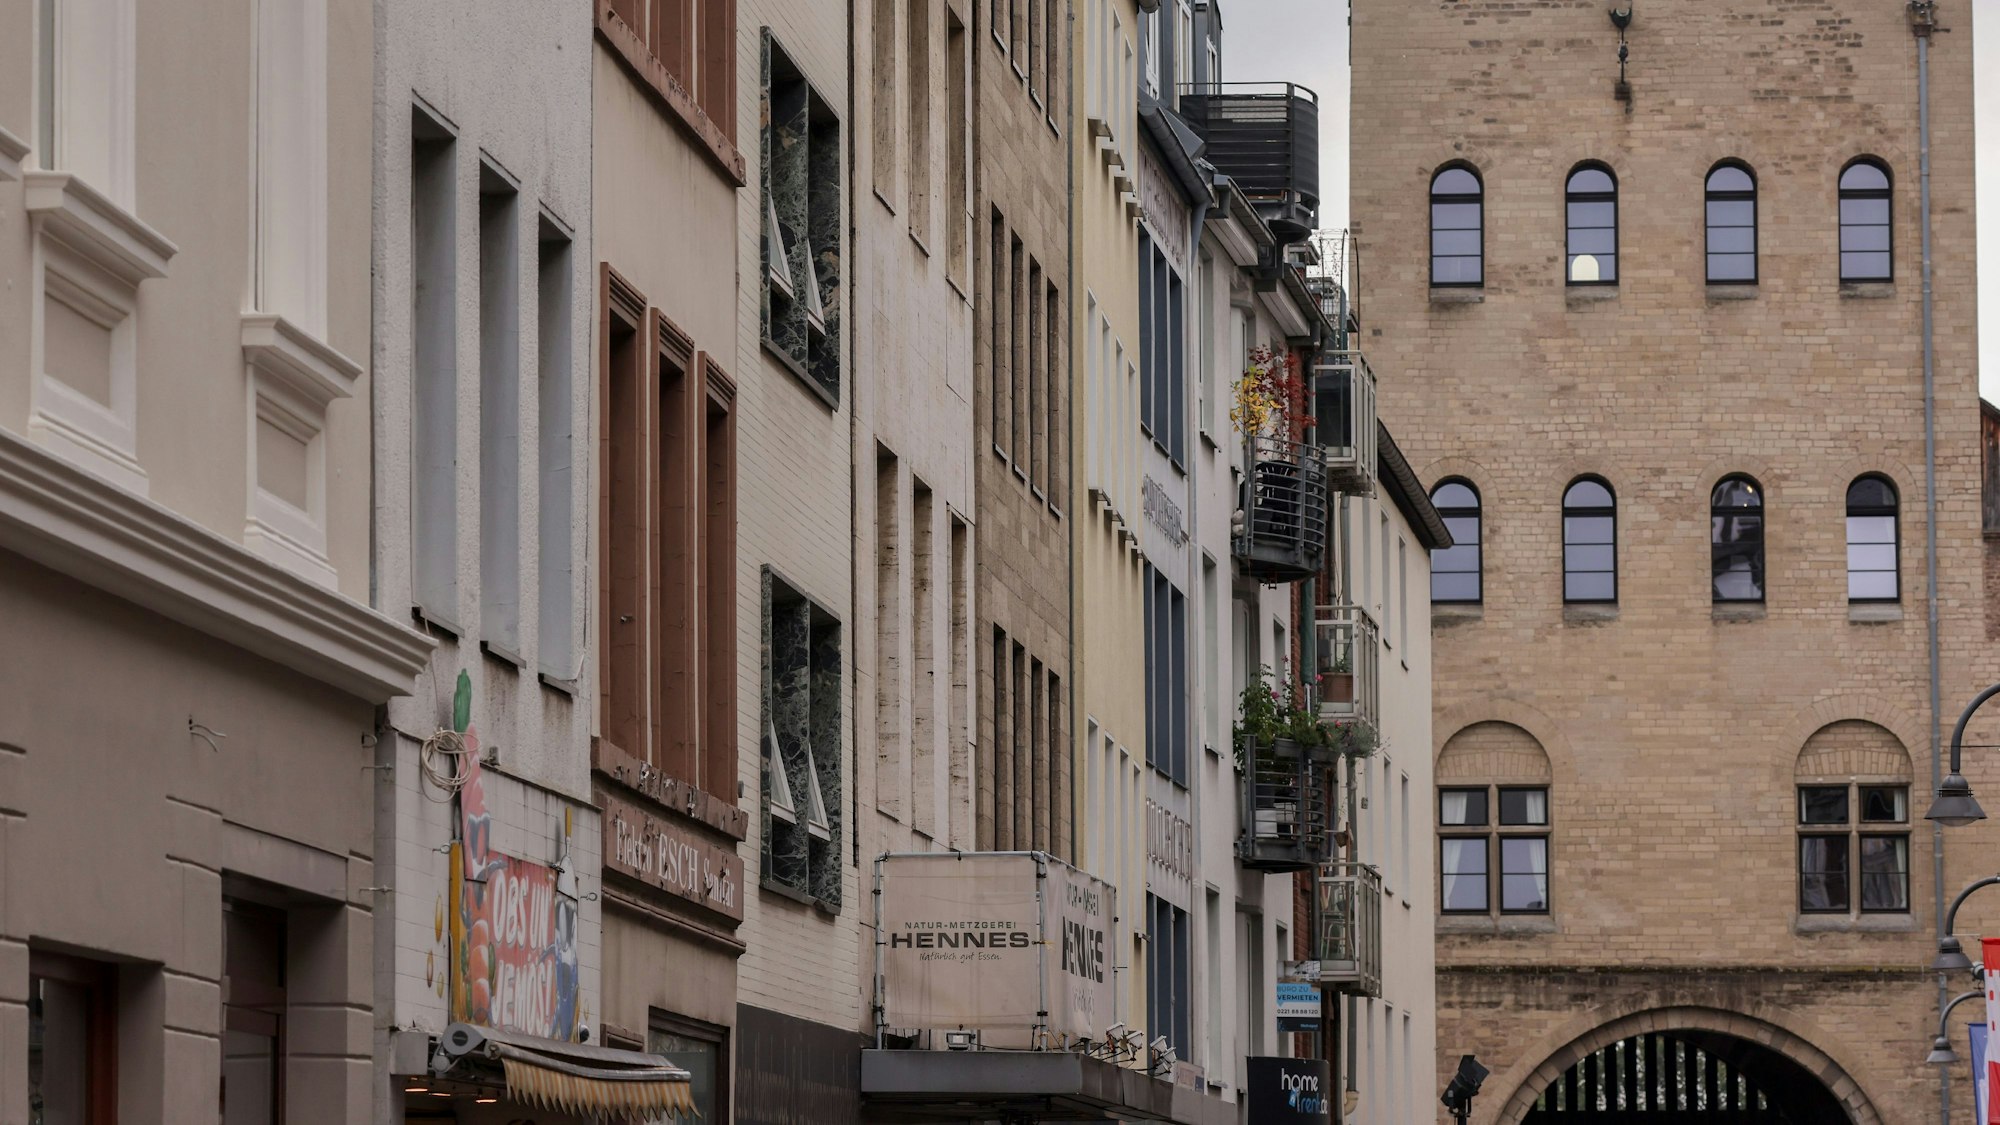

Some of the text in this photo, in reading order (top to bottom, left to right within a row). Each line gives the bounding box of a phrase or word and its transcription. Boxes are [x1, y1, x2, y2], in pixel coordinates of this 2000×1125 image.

[657, 833, 699, 893] ESCH
[493, 869, 528, 947] OBS
[905, 921, 1017, 929] NATUR-METZGEREI
[891, 932, 1030, 949] HENNES
[919, 951, 1002, 964] Natürlich gut Essen.
[491, 953, 552, 1038] JEMÖS!
[1281, 1067, 1319, 1092] home
